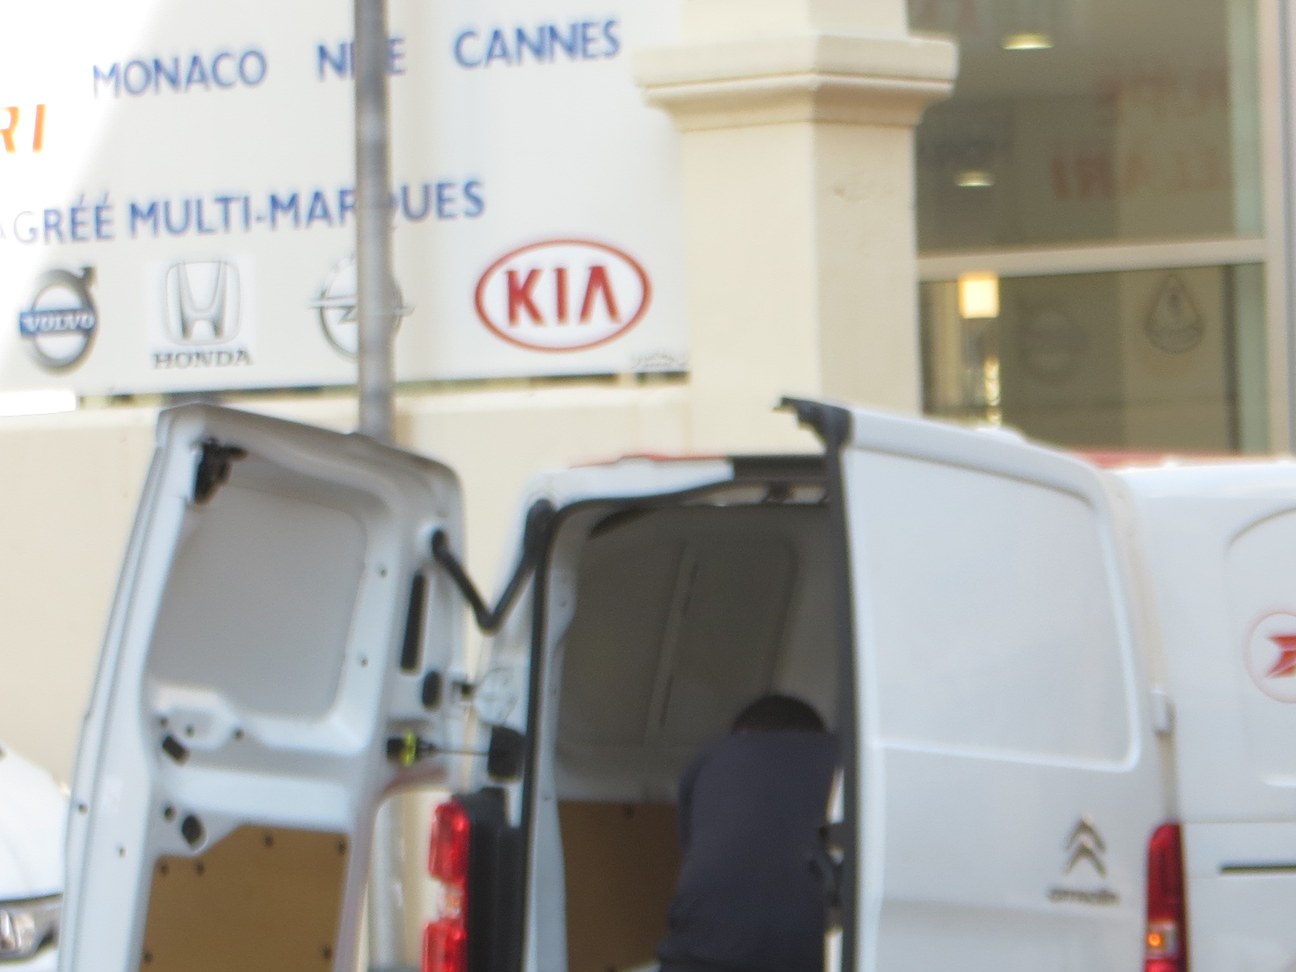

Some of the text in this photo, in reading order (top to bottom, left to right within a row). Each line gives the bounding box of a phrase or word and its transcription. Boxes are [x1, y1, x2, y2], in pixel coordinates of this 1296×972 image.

[92, 19, 622, 99] MONACO NIE CANNES
[128, 181, 486, 240] MULTI-MARUES
[505, 265, 621, 327] KIA
[152, 350, 254, 370] HONDA
